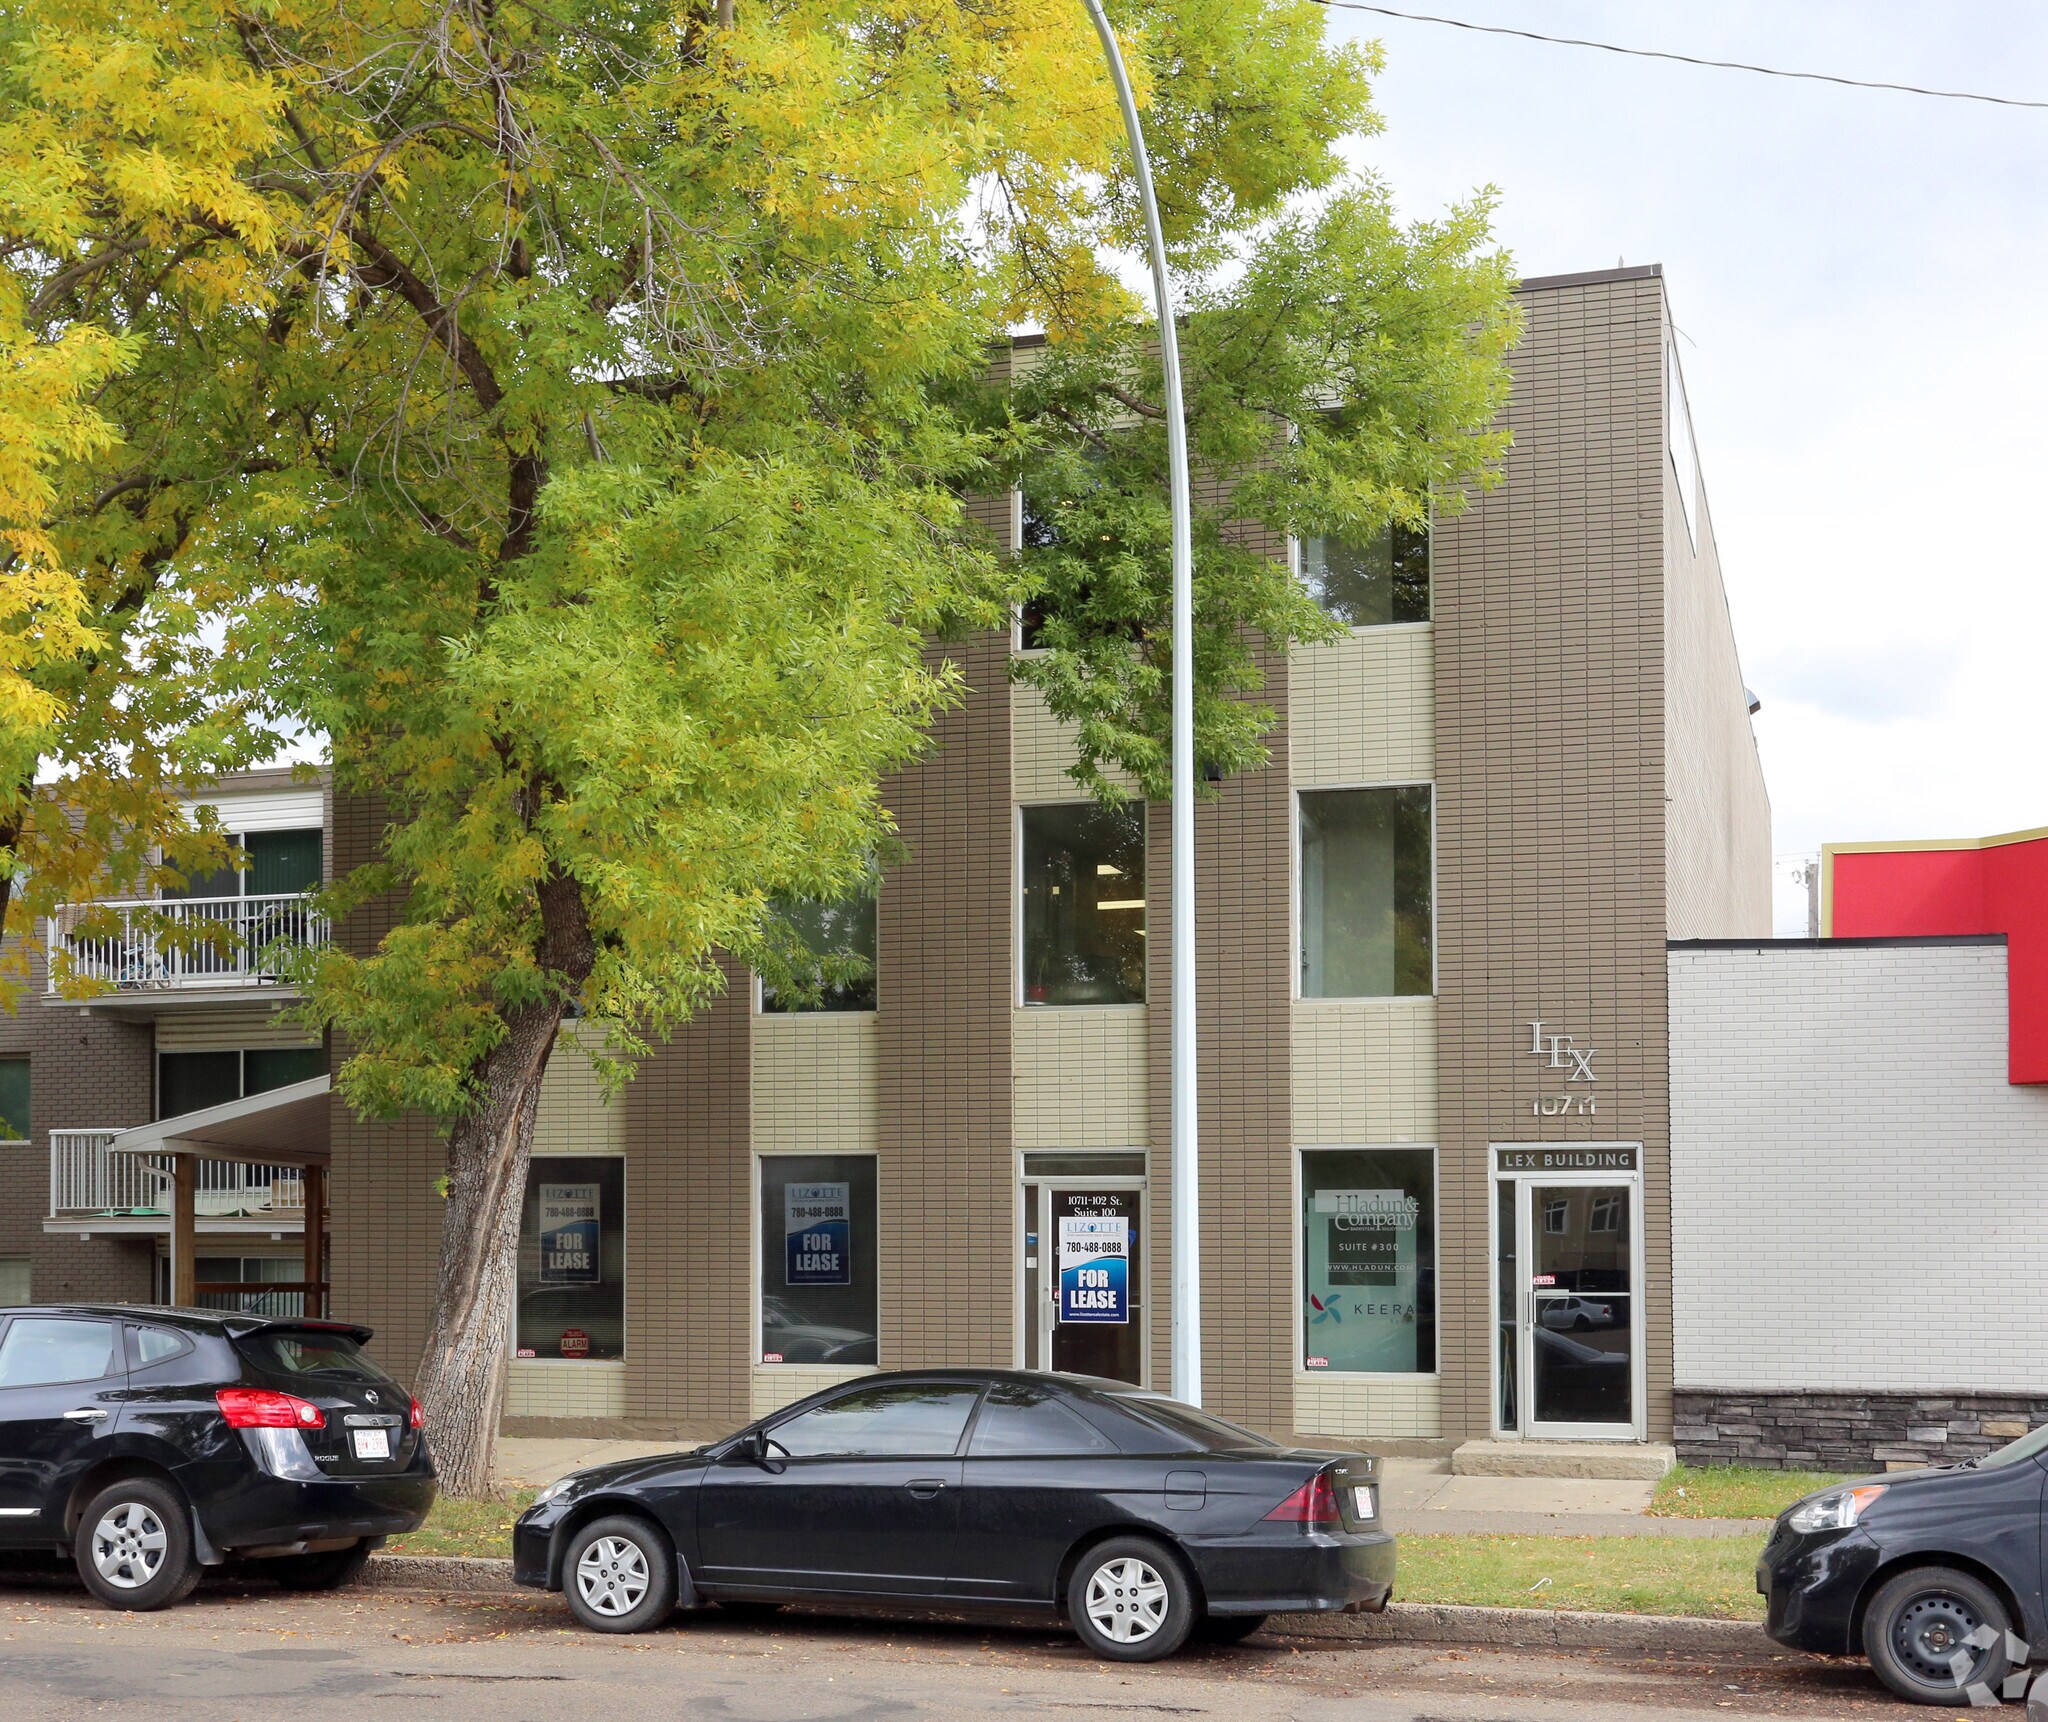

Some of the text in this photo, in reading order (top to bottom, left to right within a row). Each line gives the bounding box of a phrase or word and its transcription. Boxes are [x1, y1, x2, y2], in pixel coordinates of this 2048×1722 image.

[1527, 1021, 1599, 1081] LEX
[1531, 1095, 1596, 1116] 10711
[1505, 1153, 1629, 1167] LEX BUILDING
[546, 1188, 594, 1198] LIZOTTE
[791, 1187, 843, 1198] LIZOTTE
[1068, 1195, 1123, 1206] 10711-102 St.
[545, 1207, 594, 1217] 780-488-0888
[791, 1206, 844, 1217] 780-488-0888
[1074, 1207, 1116, 1217] Suite 100
[1066, 1222, 1121, 1232] LIZOTTE
[1334, 1212, 1418, 1231] Company
[556, 1232, 583, 1249] FOR
[803, 1233, 832, 1251] FOR
[1066, 1242, 1122, 1253] 780-488-0888
[1339, 1243, 1399, 1251] SUITE #300
[549, 1252, 590, 1269] LEASE
[796, 1253, 840, 1271] LEASE
[1078, 1269, 1109, 1288] FOR
[1070, 1290, 1117, 1309] LEASE
[1354, 1303, 1415, 1315] KEERA
[562, 1339, 587, 1348] ALARM
